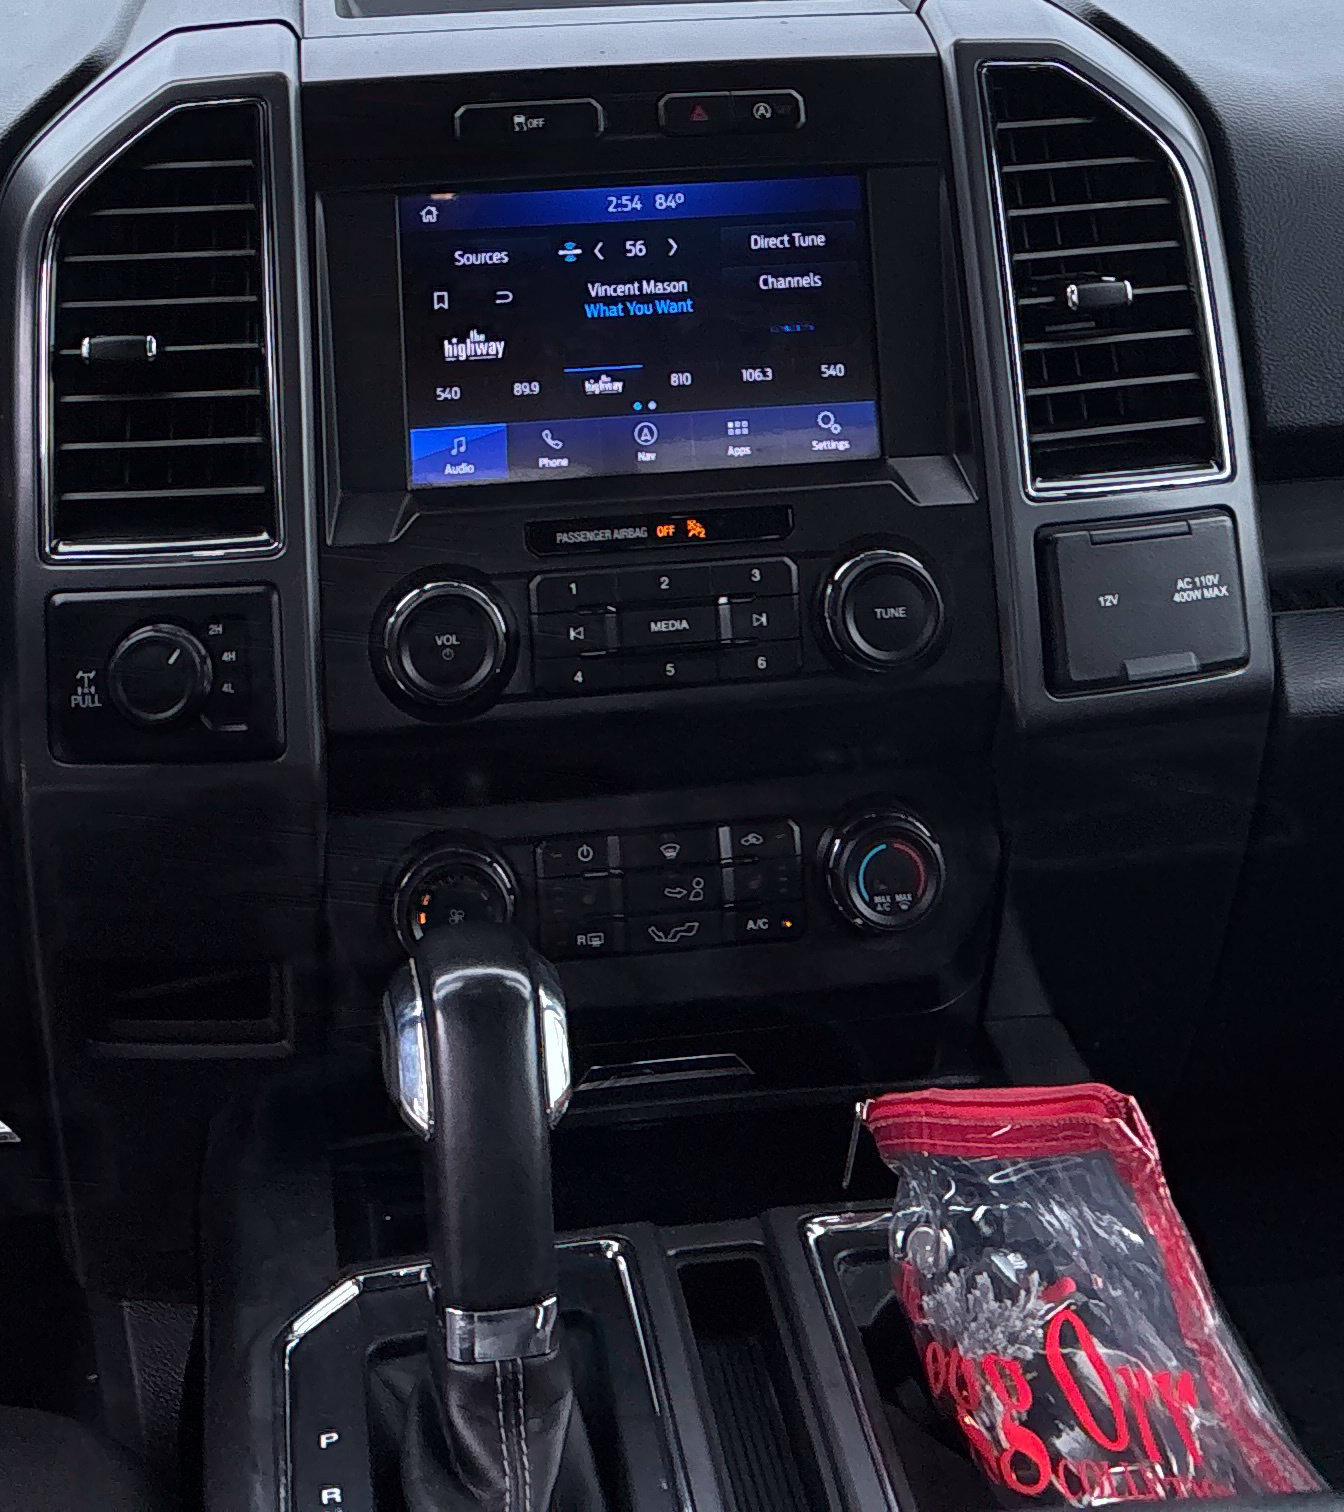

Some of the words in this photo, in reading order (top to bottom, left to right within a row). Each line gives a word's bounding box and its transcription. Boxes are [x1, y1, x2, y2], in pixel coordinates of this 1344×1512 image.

[606, 195, 642, 213] 2:54
[750, 233, 789, 251] Direct
[792, 231, 826, 249] Tune
[625, 240, 647, 257] 56
[454, 248, 509, 267] Sources
[758, 272, 822, 290] Channels
[587, 280, 639, 299] Vincent
[642, 278, 688, 296] Mason
[584, 301, 625, 320] What
[627, 299, 654, 317] You
[655, 297, 694, 316] Want
[470, 329, 485, 343] the
[443, 337, 505, 361] highway
[741, 367, 773, 382] 106.3
[820, 363, 845, 378] 540
[670, 372, 692, 386] 810
[435, 386, 461, 401] 540
[513, 382, 540, 396] 89.9
[727, 444, 751, 458] Apps
[812, 437, 850, 452] Settings
[538, 455, 569, 468] Phone
[637, 450, 656, 462] Nav
[444, 462, 474, 476] Audio
[556, 529, 613, 544] PASSENGER
[613, 526, 648, 541] AIRBAG
[656, 525, 675, 537] OFF
[751, 569, 760, 582] 3
[1176, 578, 1193, 590] AC
[1194, 574, 1220, 588] 110V
[570, 582, 577, 595] 1
[660, 577, 669, 589] 2
[1098, 594, 1119, 607] 12V
[1173, 588, 1203, 603] 400W
[1204, 586, 1229, 599] MAX
[874, 607, 907, 620] TUNE
[208, 624, 222, 635] 2H
[650, 619, 690, 633] MEDIA
[435, 634, 460, 647] VOL
[222, 651, 236, 662] 4H
[757, 656, 767, 669] 6
[574, 671, 583, 683] 4
[666, 664, 675, 676] 5
[222, 683, 235, 694] 4L
[71, 695, 103, 708] PULL
[747, 919, 769, 930] A/C
[320, 1432, 339, 1449] P
[322, 1487, 342, 1505] R
